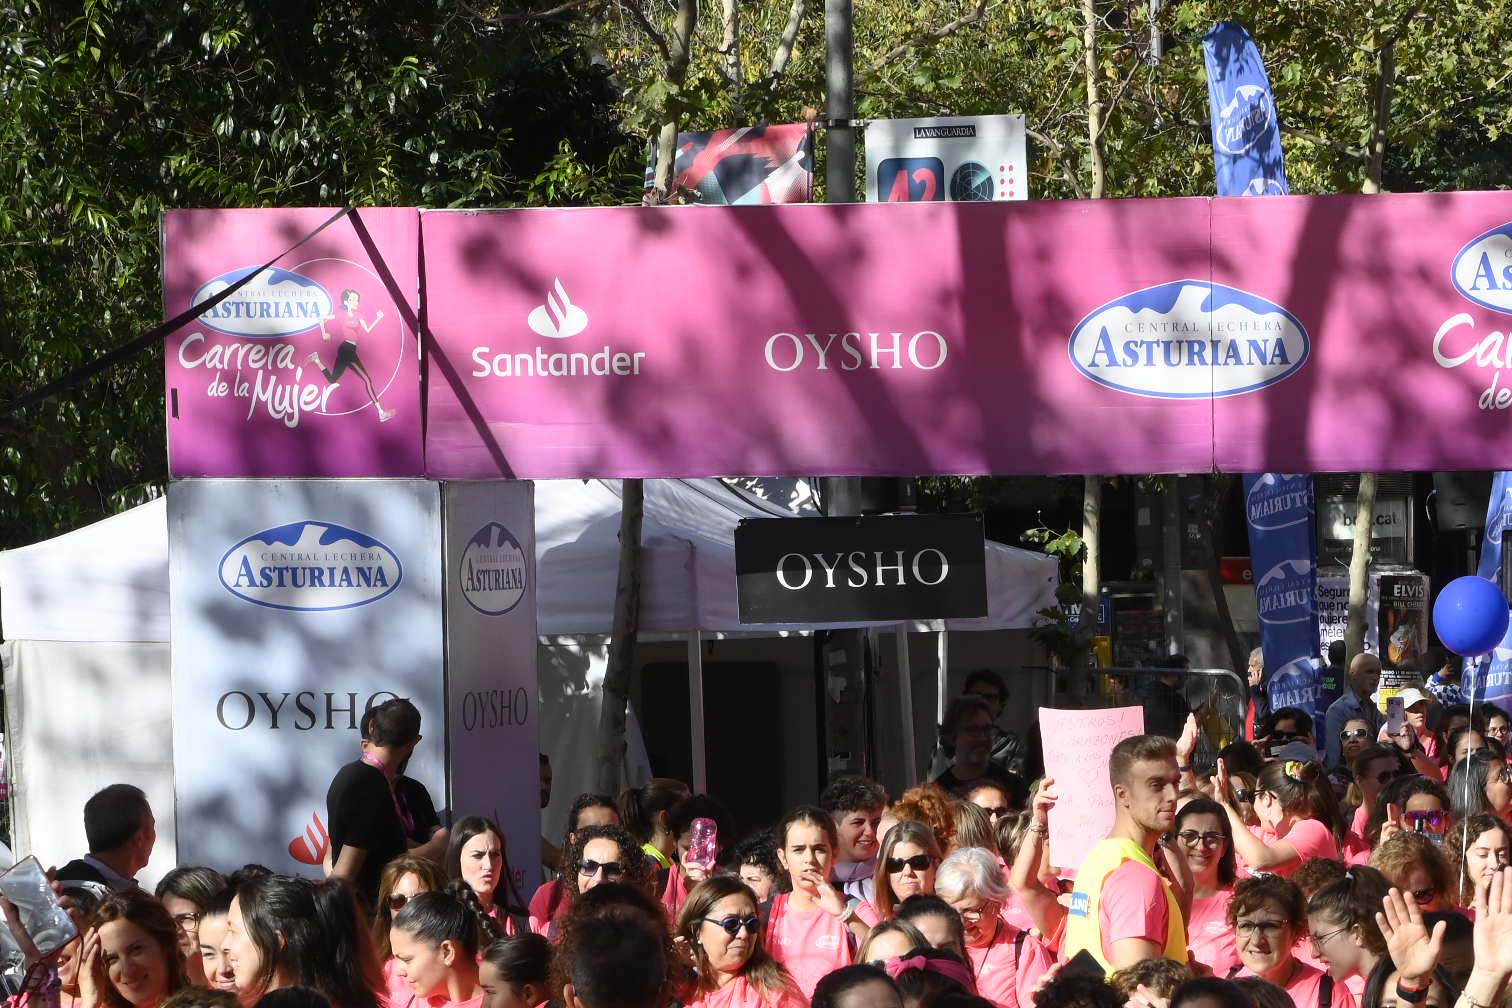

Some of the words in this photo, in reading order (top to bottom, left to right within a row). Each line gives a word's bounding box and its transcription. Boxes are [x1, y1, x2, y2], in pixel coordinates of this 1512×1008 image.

[926, 126, 975, 138] VANGUARDIA
[1124, 321, 1200, 333] CENTRAL
[1208, 320, 1283, 332] LECHERA
[178, 332, 295, 370] Carrera
[471, 346, 646, 378] Santander
[764, 331, 948, 373] OYSHO
[1087, 325, 1292, 369] ASTURIANA
[207, 371, 229, 397] de
[233, 371, 249, 397] la
[247, 366, 341, 428] Mujer
[1478, 372, 1512, 411] de
[232, 554, 389, 589] ASTURIANA
[260, 552, 320, 562] CENTRAL
[324, 551, 383, 562] LECHERA
[776, 547, 950, 590] OYSHO
[465, 558, 523, 593] ASTURIANA
[1318, 584, 1351, 600] Segur
[1393, 584, 1425, 597] ELVIS
[1318, 599, 1335, 611] que
[1319, 612, 1351, 625] quiere
[462, 687, 529, 732] OYSHO
